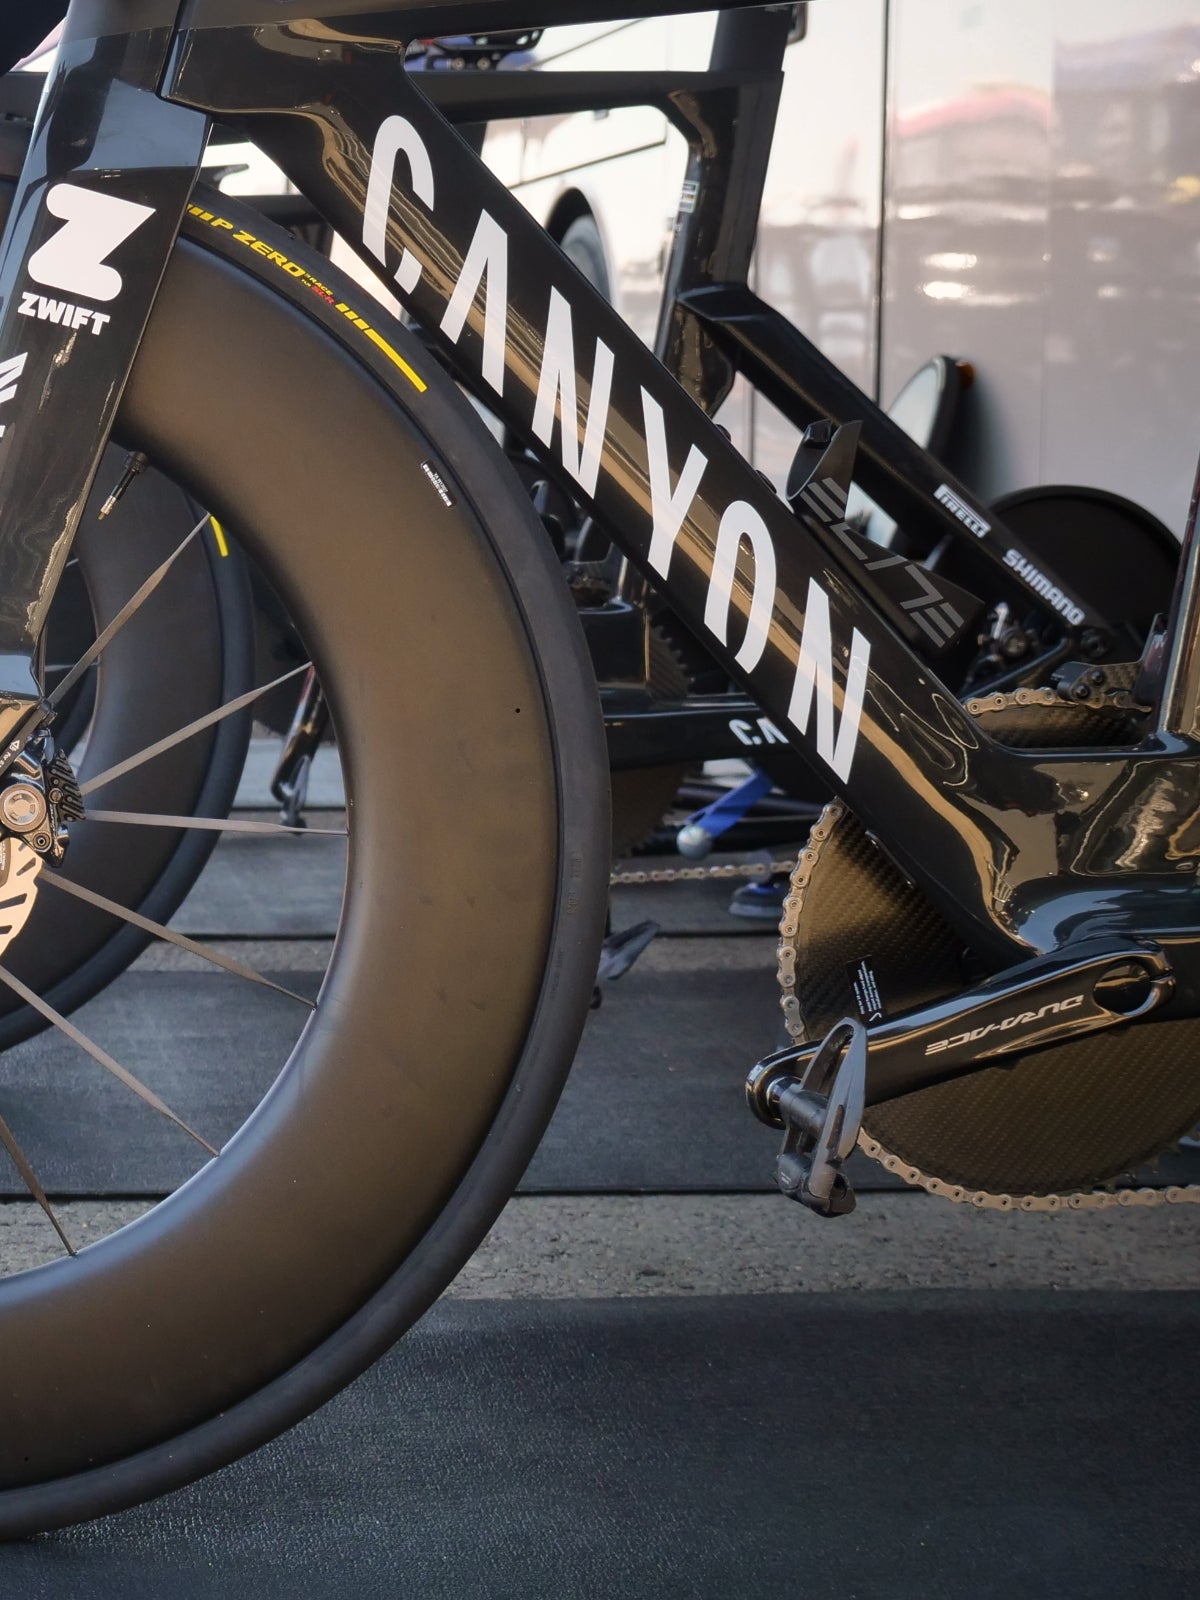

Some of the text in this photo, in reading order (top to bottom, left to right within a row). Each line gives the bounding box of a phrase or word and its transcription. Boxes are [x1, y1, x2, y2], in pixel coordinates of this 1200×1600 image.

[210, 217, 305, 277] P ZERO
[17, 291, 111, 335] ZWIFT
[362, 115, 872, 784] CANYON
[933, 483, 992, 538] PIRELLI
[800, 477, 965, 648] ELITE
[1002, 549, 1086, 625] SHIMANO
[924, 995, 1084, 1056] DURA-ACE
